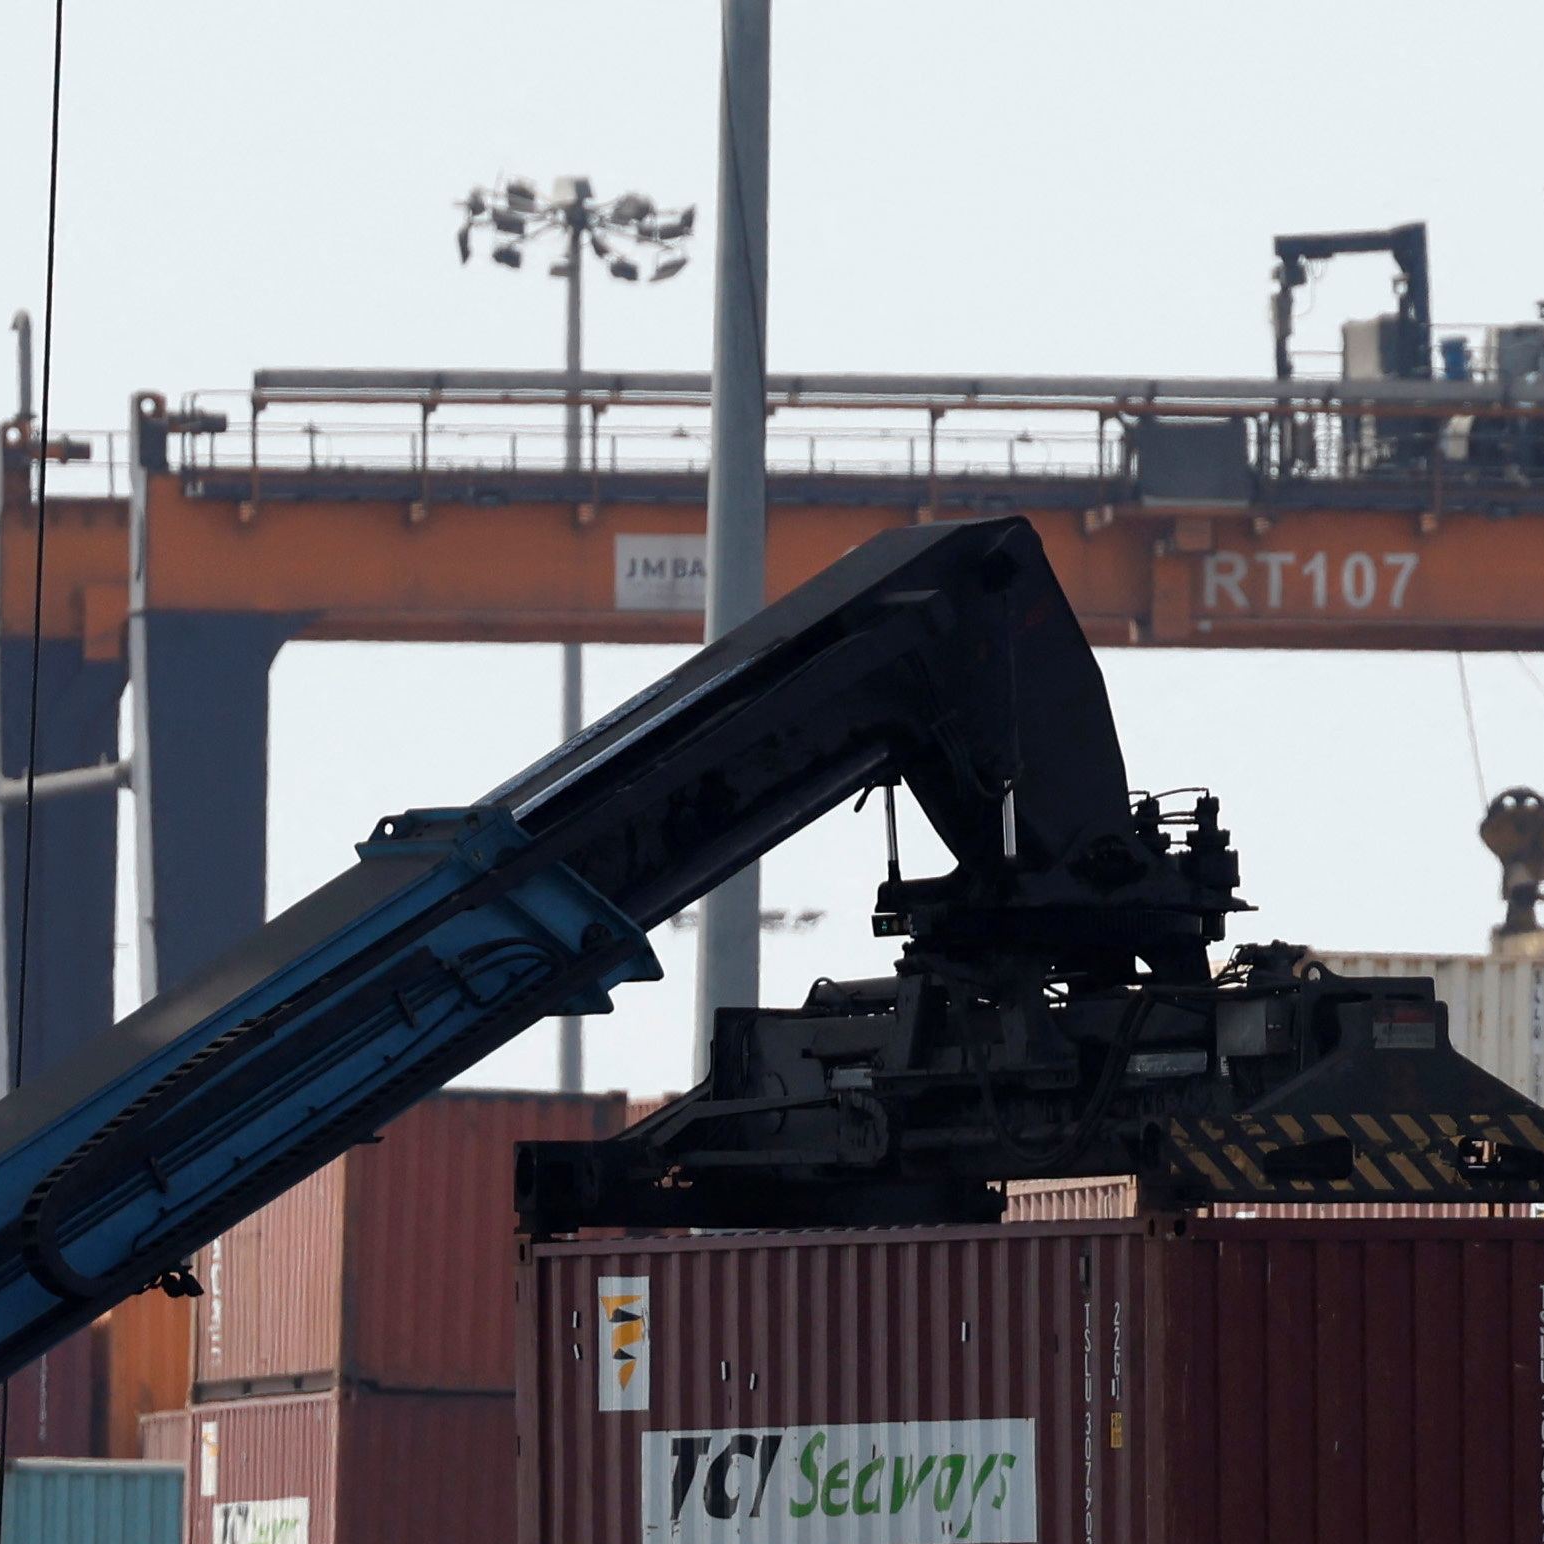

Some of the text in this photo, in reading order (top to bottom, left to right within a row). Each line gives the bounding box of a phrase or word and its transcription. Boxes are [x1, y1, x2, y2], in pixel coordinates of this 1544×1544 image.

[673, 557, 706, 578] BA
[1202, 551, 1420, 610] RT107
[1084, 1303, 1093, 1402] TSLU
[1113, 1301, 1122, 1401] 22G1
[669, 1430, 1017, 1539] TCI Seaways
